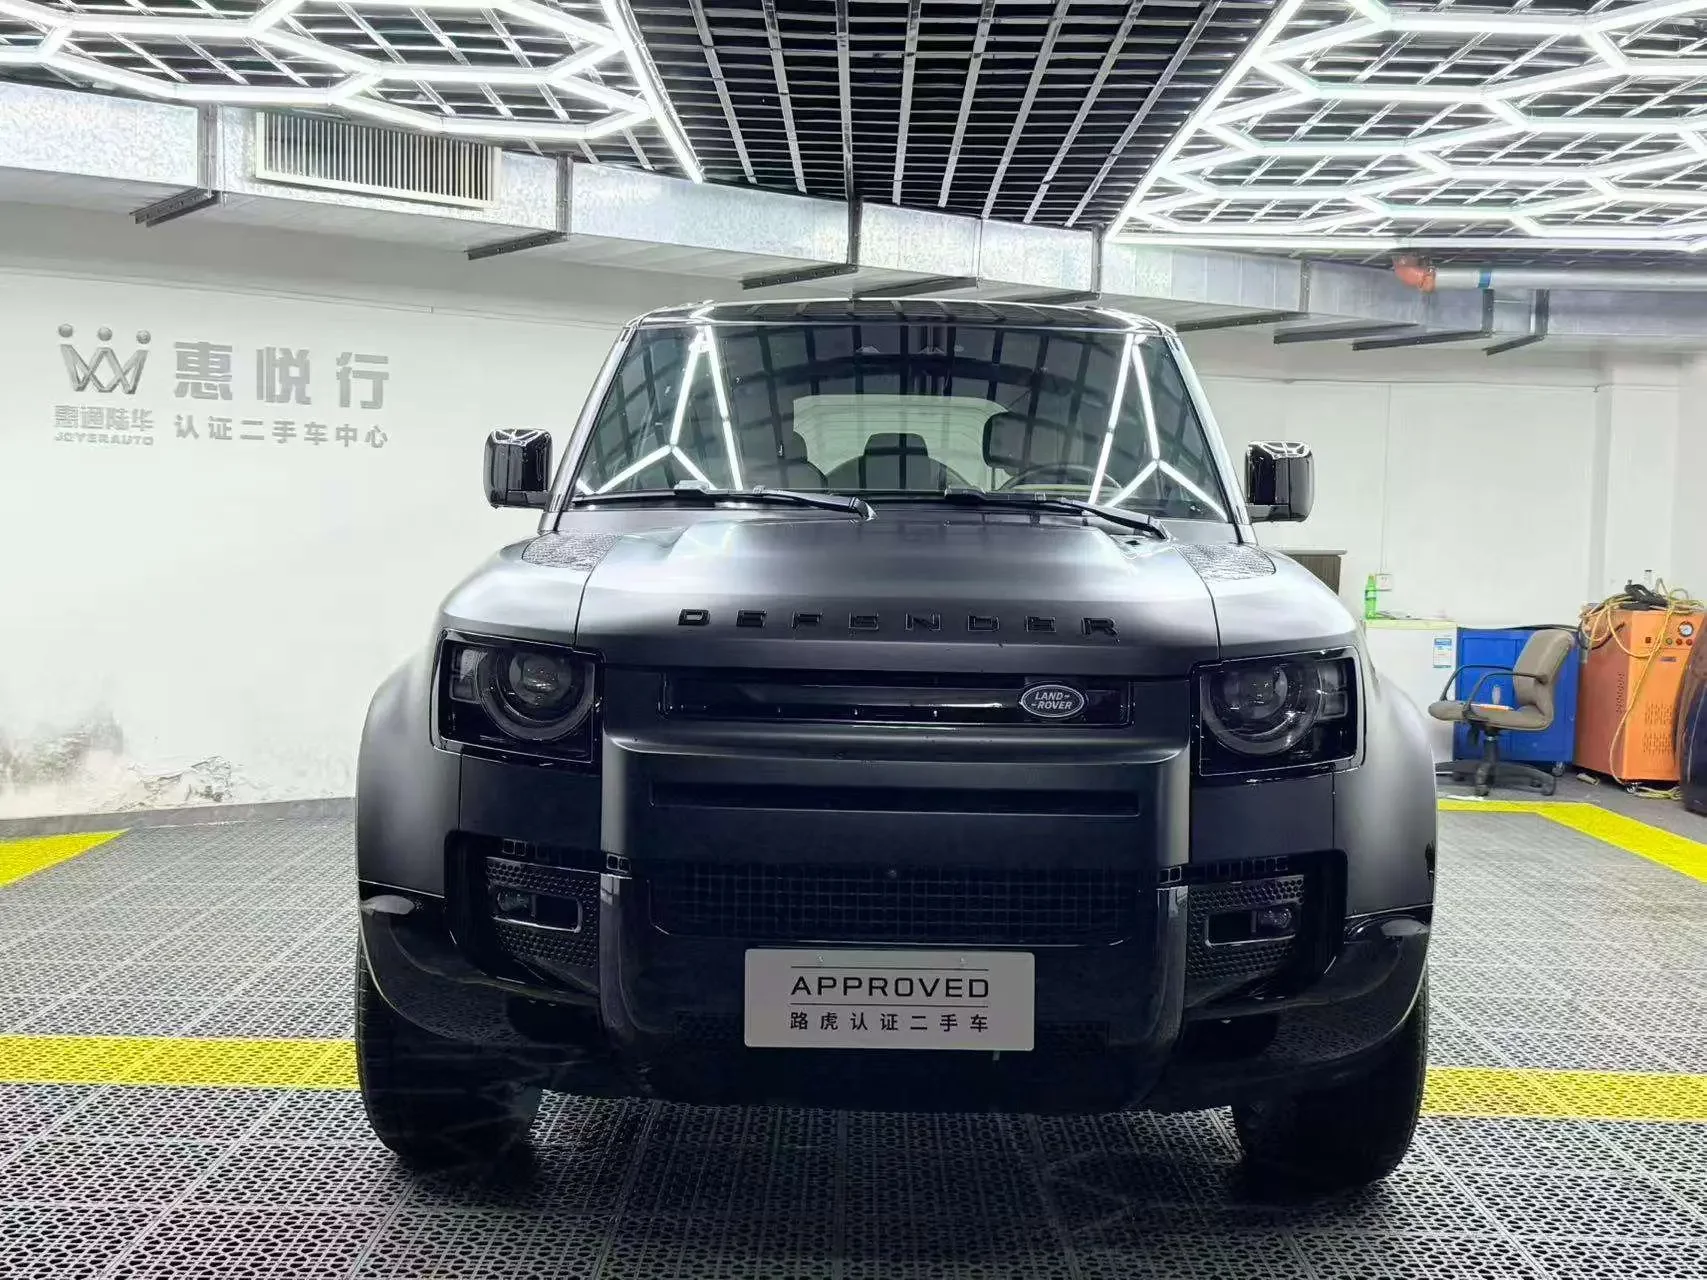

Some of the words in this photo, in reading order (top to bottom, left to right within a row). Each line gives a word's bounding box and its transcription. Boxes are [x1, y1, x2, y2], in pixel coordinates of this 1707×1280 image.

[174, 341, 390, 410] 惠悦行
[174, 414, 389, 448] 认证二手车中心
[677, 607, 1120, 637] DEFENDER
[790, 976, 990, 998] APPROVED
[789, 1011, 989, 1033] 路虎认证二手车
